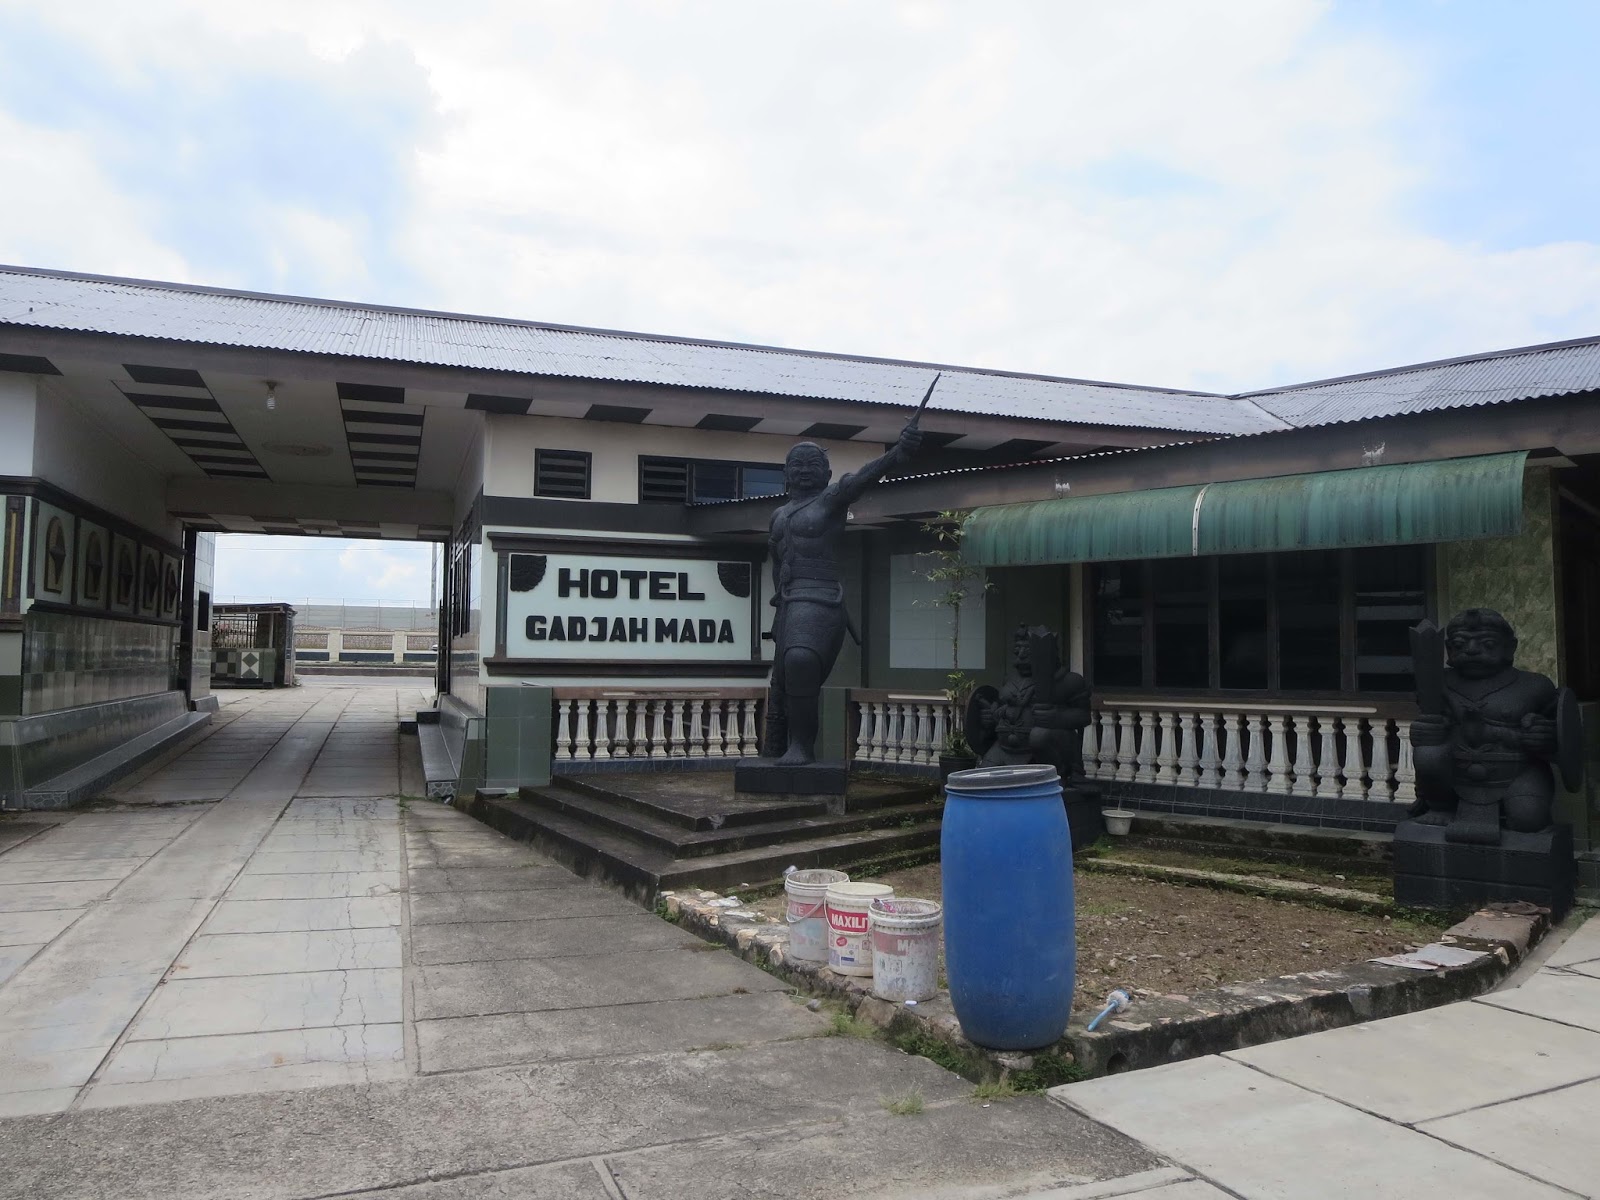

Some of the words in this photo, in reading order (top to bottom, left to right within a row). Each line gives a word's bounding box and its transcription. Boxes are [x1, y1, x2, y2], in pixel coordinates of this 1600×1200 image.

[558, 568, 705, 600] HOTEL
[526, 615, 648, 642] GADJAH
[655, 617, 734, 643] MADA
[831, 913, 868, 929] MAXILI
